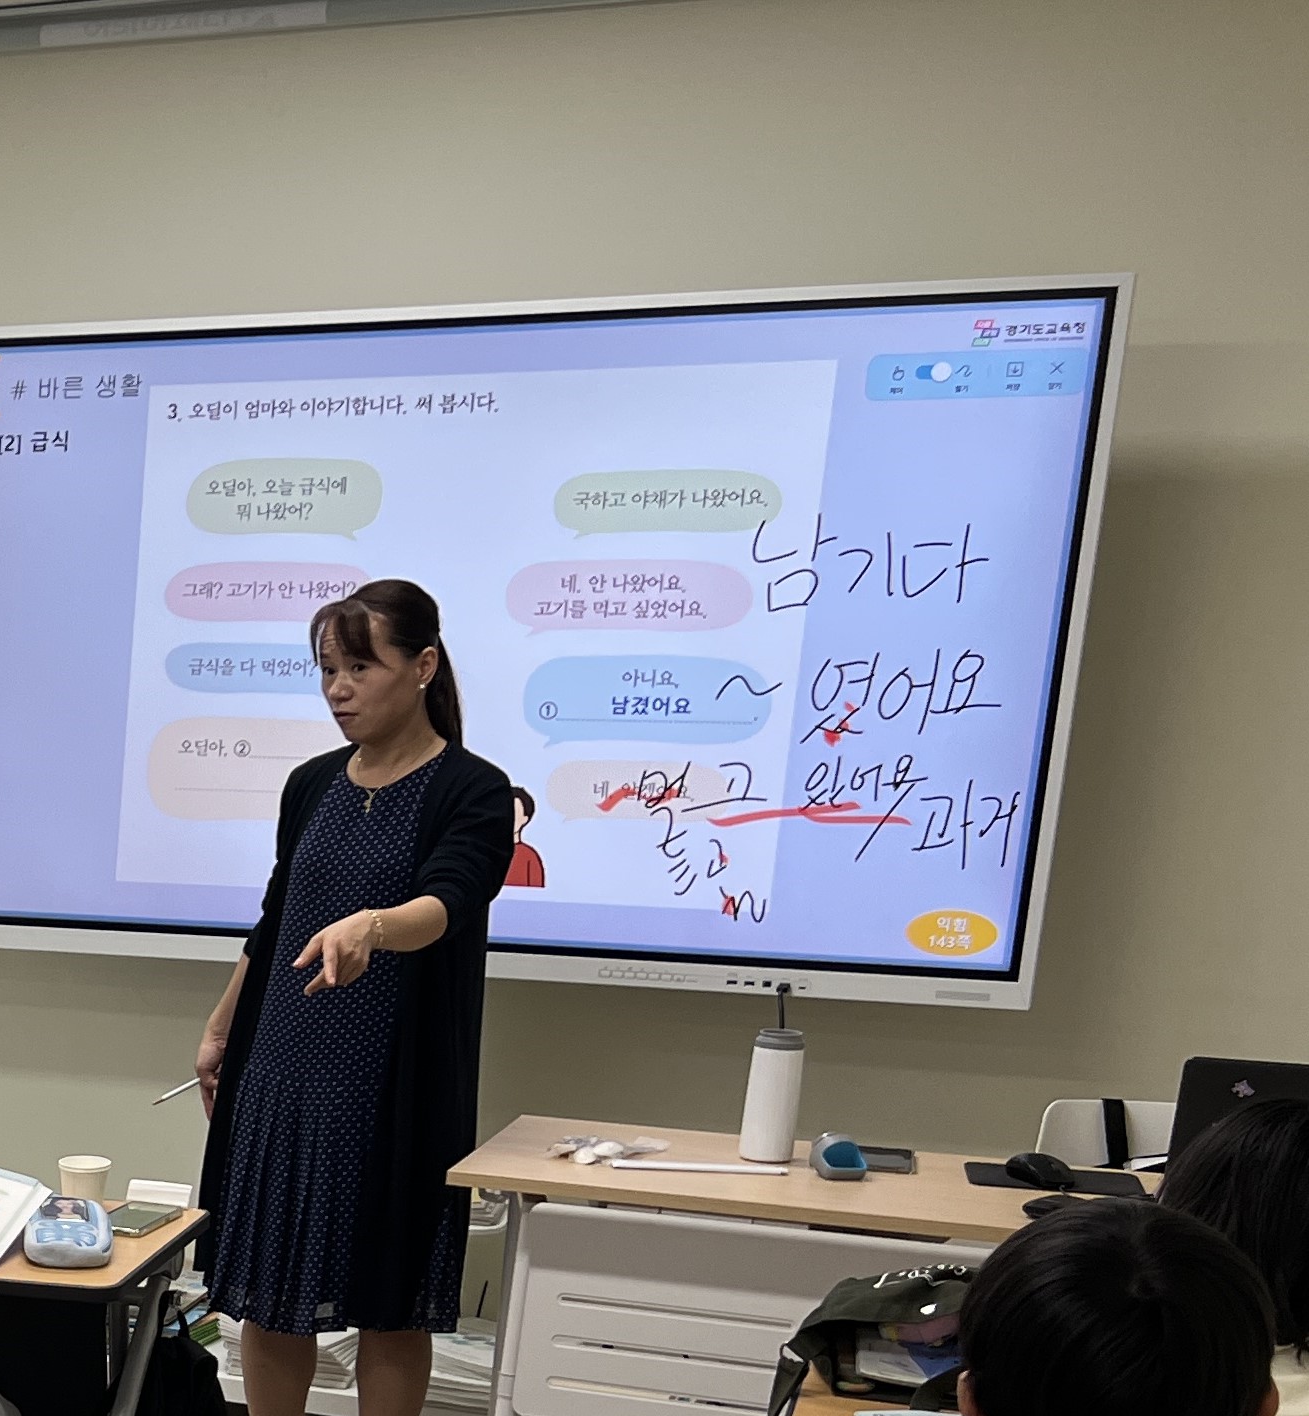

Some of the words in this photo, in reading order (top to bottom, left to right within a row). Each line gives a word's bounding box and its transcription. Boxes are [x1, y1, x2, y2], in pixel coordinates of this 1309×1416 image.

[11, 379, 27, 400] #
[38, 375, 84, 400] 바른
[95, 373, 143, 399] 생활
[167, 403, 183, 422] 3.
[244, 398, 296, 419] 엄마와
[300, 395, 408, 417] 이야기합니다.
[414, 394, 433, 414] 써
[438, 391, 500, 416] 봅시다.
[30, 430, 69, 453] 급식
[261, 477, 296, 496] 오늘
[299, 476, 348, 496] 급식에
[573, 489, 627, 510] 국하고
[632, 489, 686, 510] 야채가
[692, 488, 769, 509] 나왔어요.
[236, 503, 251, 521] 뭐
[257, 502, 314, 521] 나왔어?
[751, 512, 990, 613] 남기다
[183, 581, 223, 600] 그래?
[226, 580, 275, 600] 고기가
[278, 581, 296, 600] 안
[300, 580, 356, 600] 나왔어?
[589, 573, 607, 593] 안
[612, 573, 687, 593] 나왔어요.
[534, 599, 587, 619] 고기를
[593, 599, 627, 619] 먹고
[632, 599, 708, 620] 싶었어요.
[188, 657, 236, 677] 급식을
[240, 657, 256, 676] 다
[260, 657, 317, 678] 먹었어?
[622, 669, 679, 689] 아니요,
[611, 696, 692, 717] 남겼어요
[233, 739, 252, 758] ②
[911, 779, 1021, 870] 과거
